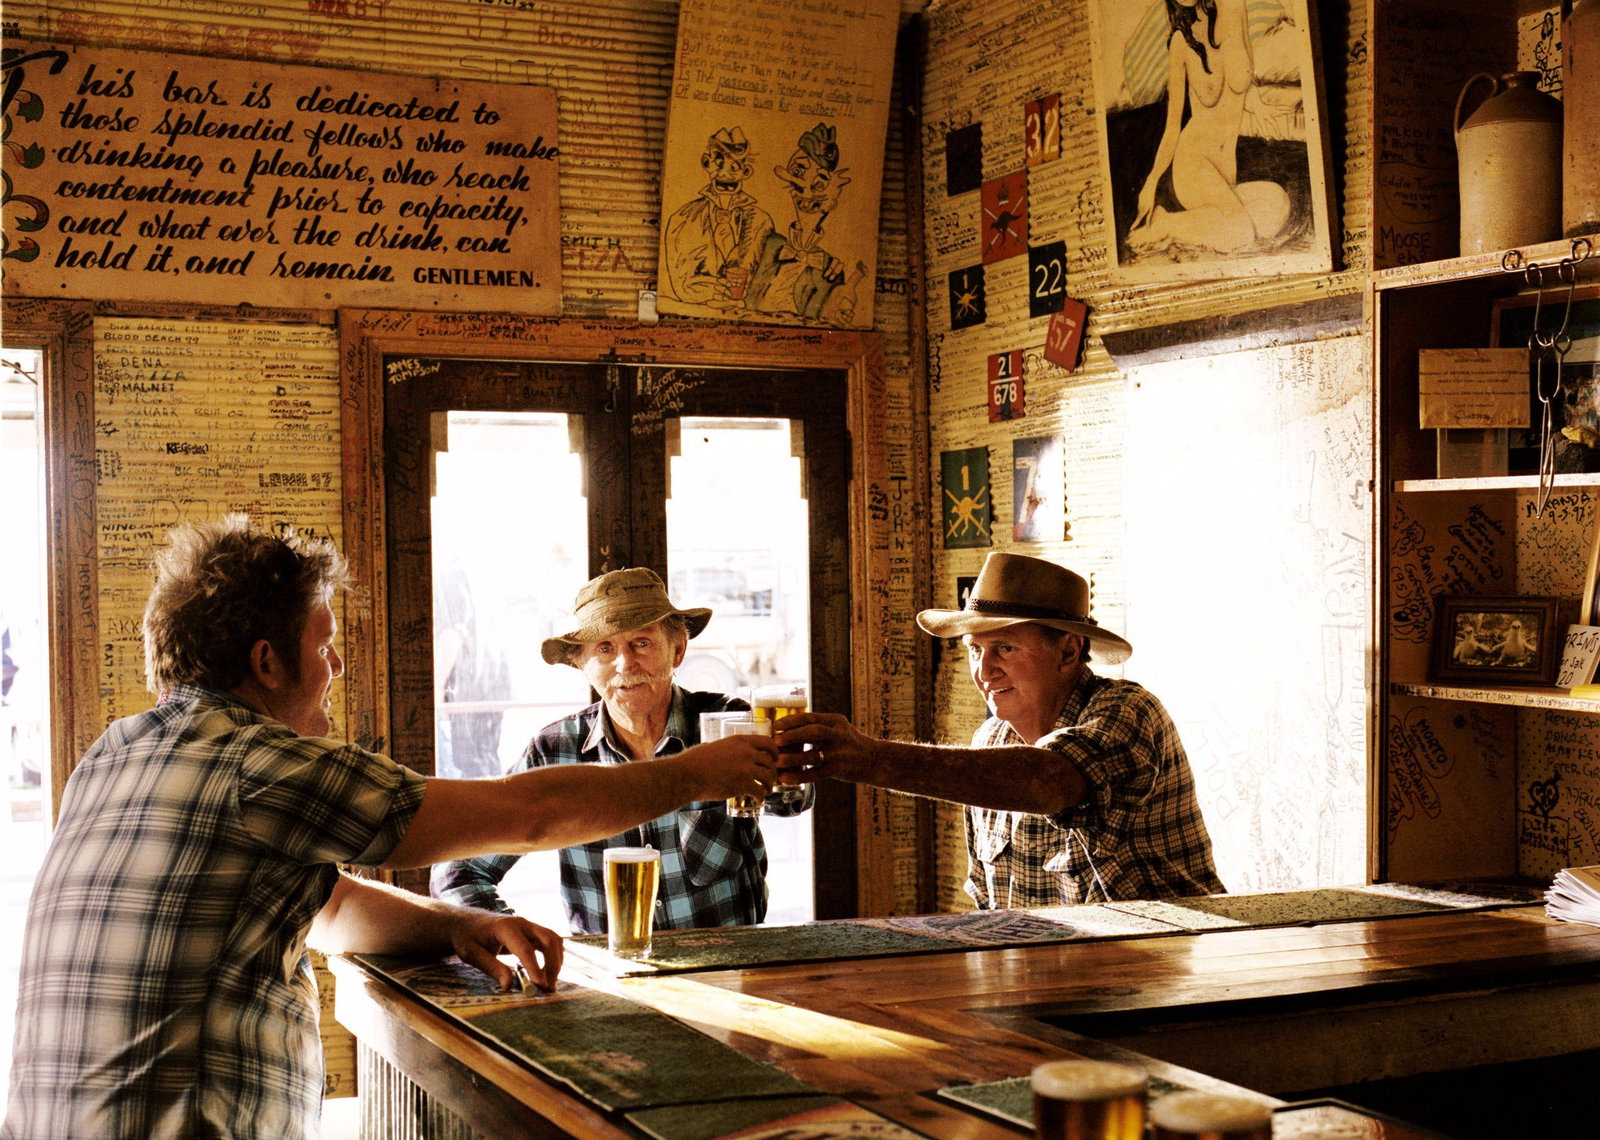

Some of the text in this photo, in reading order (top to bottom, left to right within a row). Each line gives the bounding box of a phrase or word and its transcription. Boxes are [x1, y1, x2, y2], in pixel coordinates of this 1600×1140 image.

[163, 70, 228, 106] bar
[241, 82, 273, 109] is
[296, 86, 460, 123] dedicated
[473, 102, 501, 125] to
[712, 91, 747, 106] drunken
[60, 98, 560, 162] those splendid fellows who make
[56, 139, 531, 192] drinking a pleasure, who reach
[54, 175, 529, 235] contentment prior to capacity,
[58, 209, 511, 254] and what ever the drink, can
[561, 235, 621, 250] SMITH
[1379, 225, 1432, 253] MOOSE
[54, 236, 138, 271] hold
[185, 250, 255, 276] and
[269, 250, 395, 282] remain
[413, 266, 542, 288] GENTLEMEN.
[1034, 258, 1062, 299] 22
[103, 332, 140, 342] BLOOD
[145, 334, 181, 343] BEACH
[120, 356, 164, 369] DENA
[386, 358, 421, 375] JAMES
[387, 362, 441, 385] TOMPSON
[997, 353, 1012, 377] 21
[652, 369, 677, 397] SCOTT
[993, 383, 1018, 406] 678
[960, 465, 970, 491] 1
[102, 523, 137, 533] NINO
[1565, 631, 1600, 655] PRINTS
[1557, 670, 1574, 686] 20
[1416, 718, 1449, 765] MORTO
